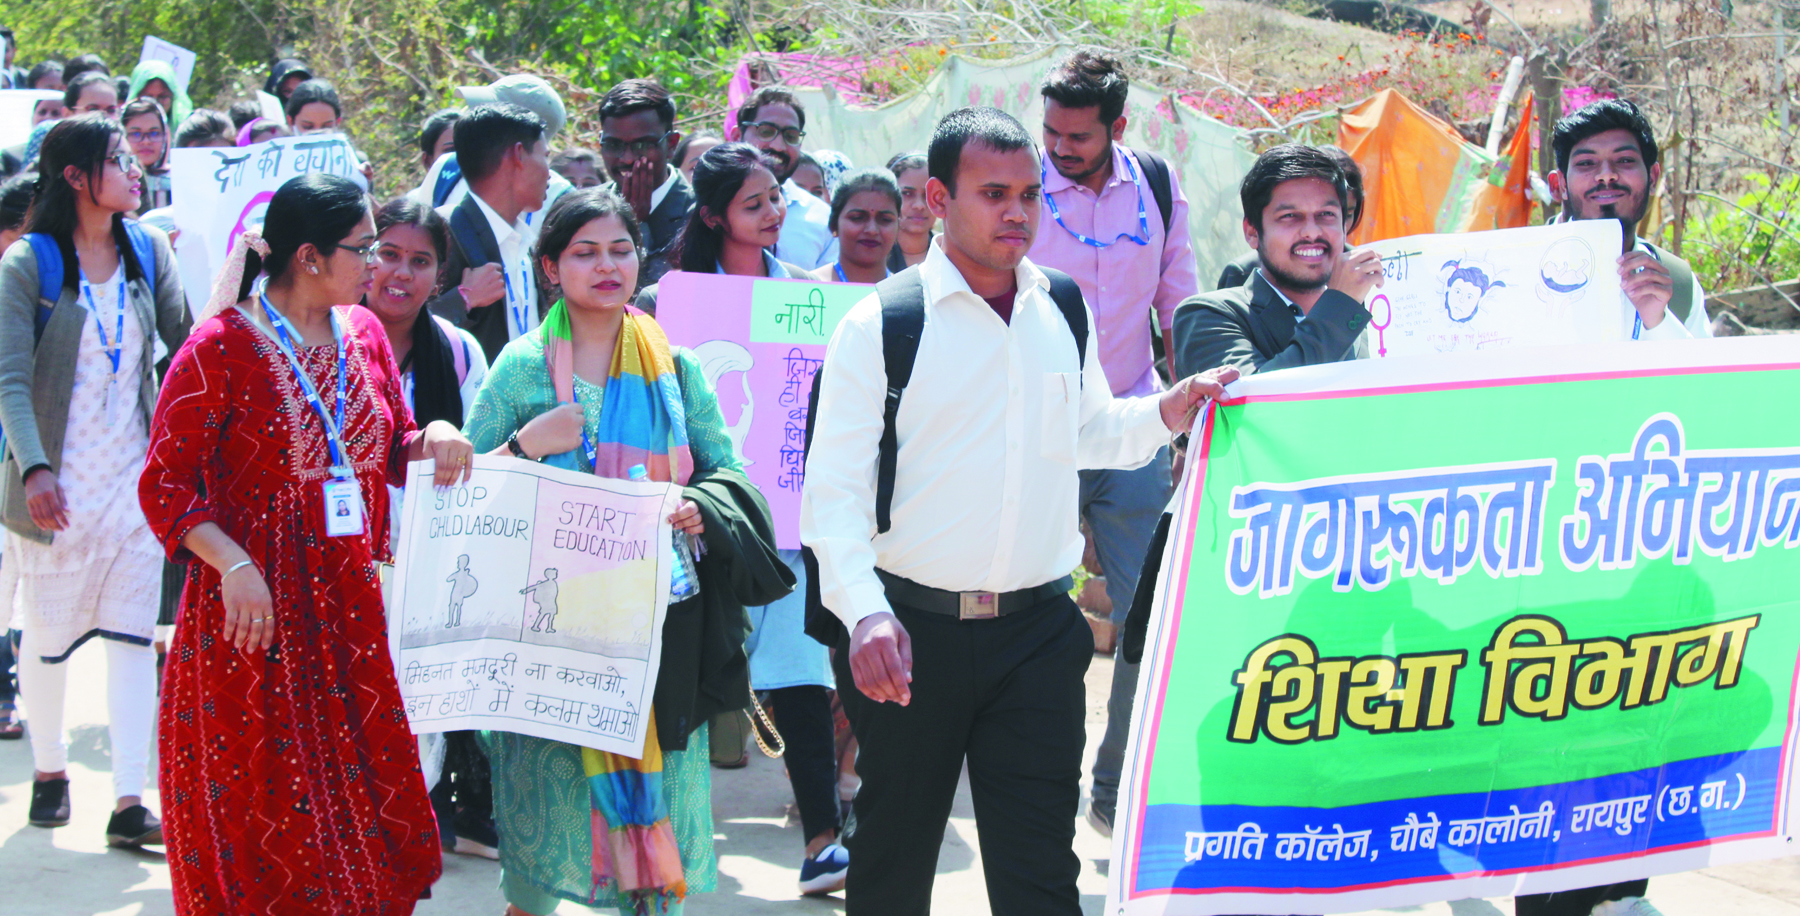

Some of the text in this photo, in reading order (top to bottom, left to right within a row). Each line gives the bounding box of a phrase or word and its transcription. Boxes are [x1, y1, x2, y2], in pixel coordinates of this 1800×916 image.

[257, 141, 285, 180] को
[434, 486, 488, 511] STOP
[559, 501, 636, 537] START
[1226, 458, 1556, 597] जागरूकता
[554, 529, 646, 562] EDUCATION
[461, 652, 518, 684] मजदूरी
[525, 662, 552, 681] ना
[1227, 612, 1762, 745] शिक्षा विभाग
[404, 679, 639, 740] इन हाथों में कलम थमाओ
[1184, 822, 1268, 862] प्रगति
[1275, 823, 1378, 862] कॉलेज,
[1390, 812, 1441, 852] चौबे
[1447, 801, 1560, 848] कालोनी,
[1570, 794, 1652, 836] रायपुर
